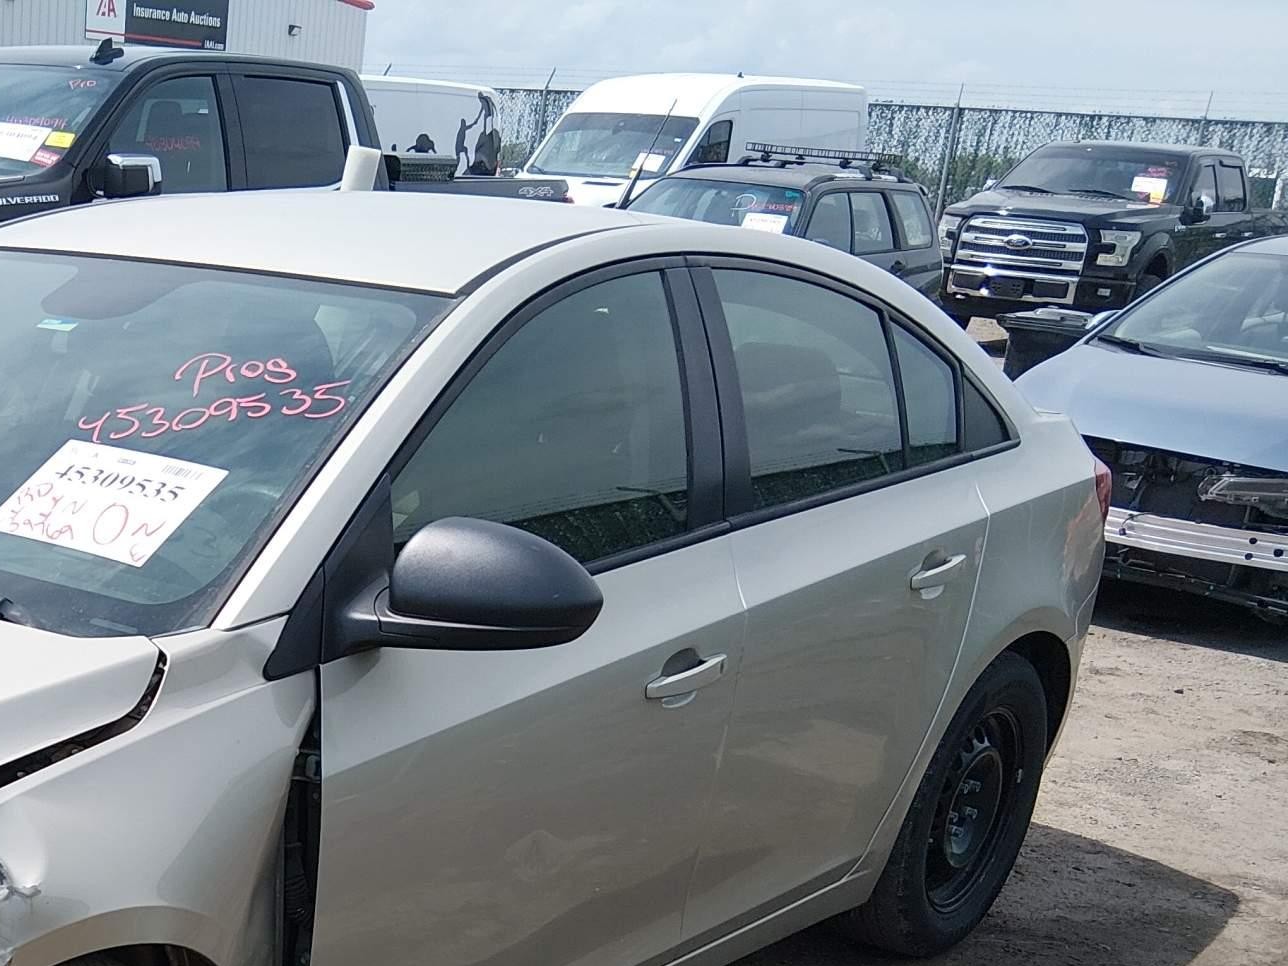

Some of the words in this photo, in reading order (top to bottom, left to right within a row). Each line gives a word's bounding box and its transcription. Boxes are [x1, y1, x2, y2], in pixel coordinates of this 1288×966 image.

[133, 3, 170, 20] Insurance
[171, 8, 188, 23] Auto
[190, 11, 220, 27] Auctions
[78, 380, 351, 443] 45309535
[55, 463, 187, 502] 45309535
